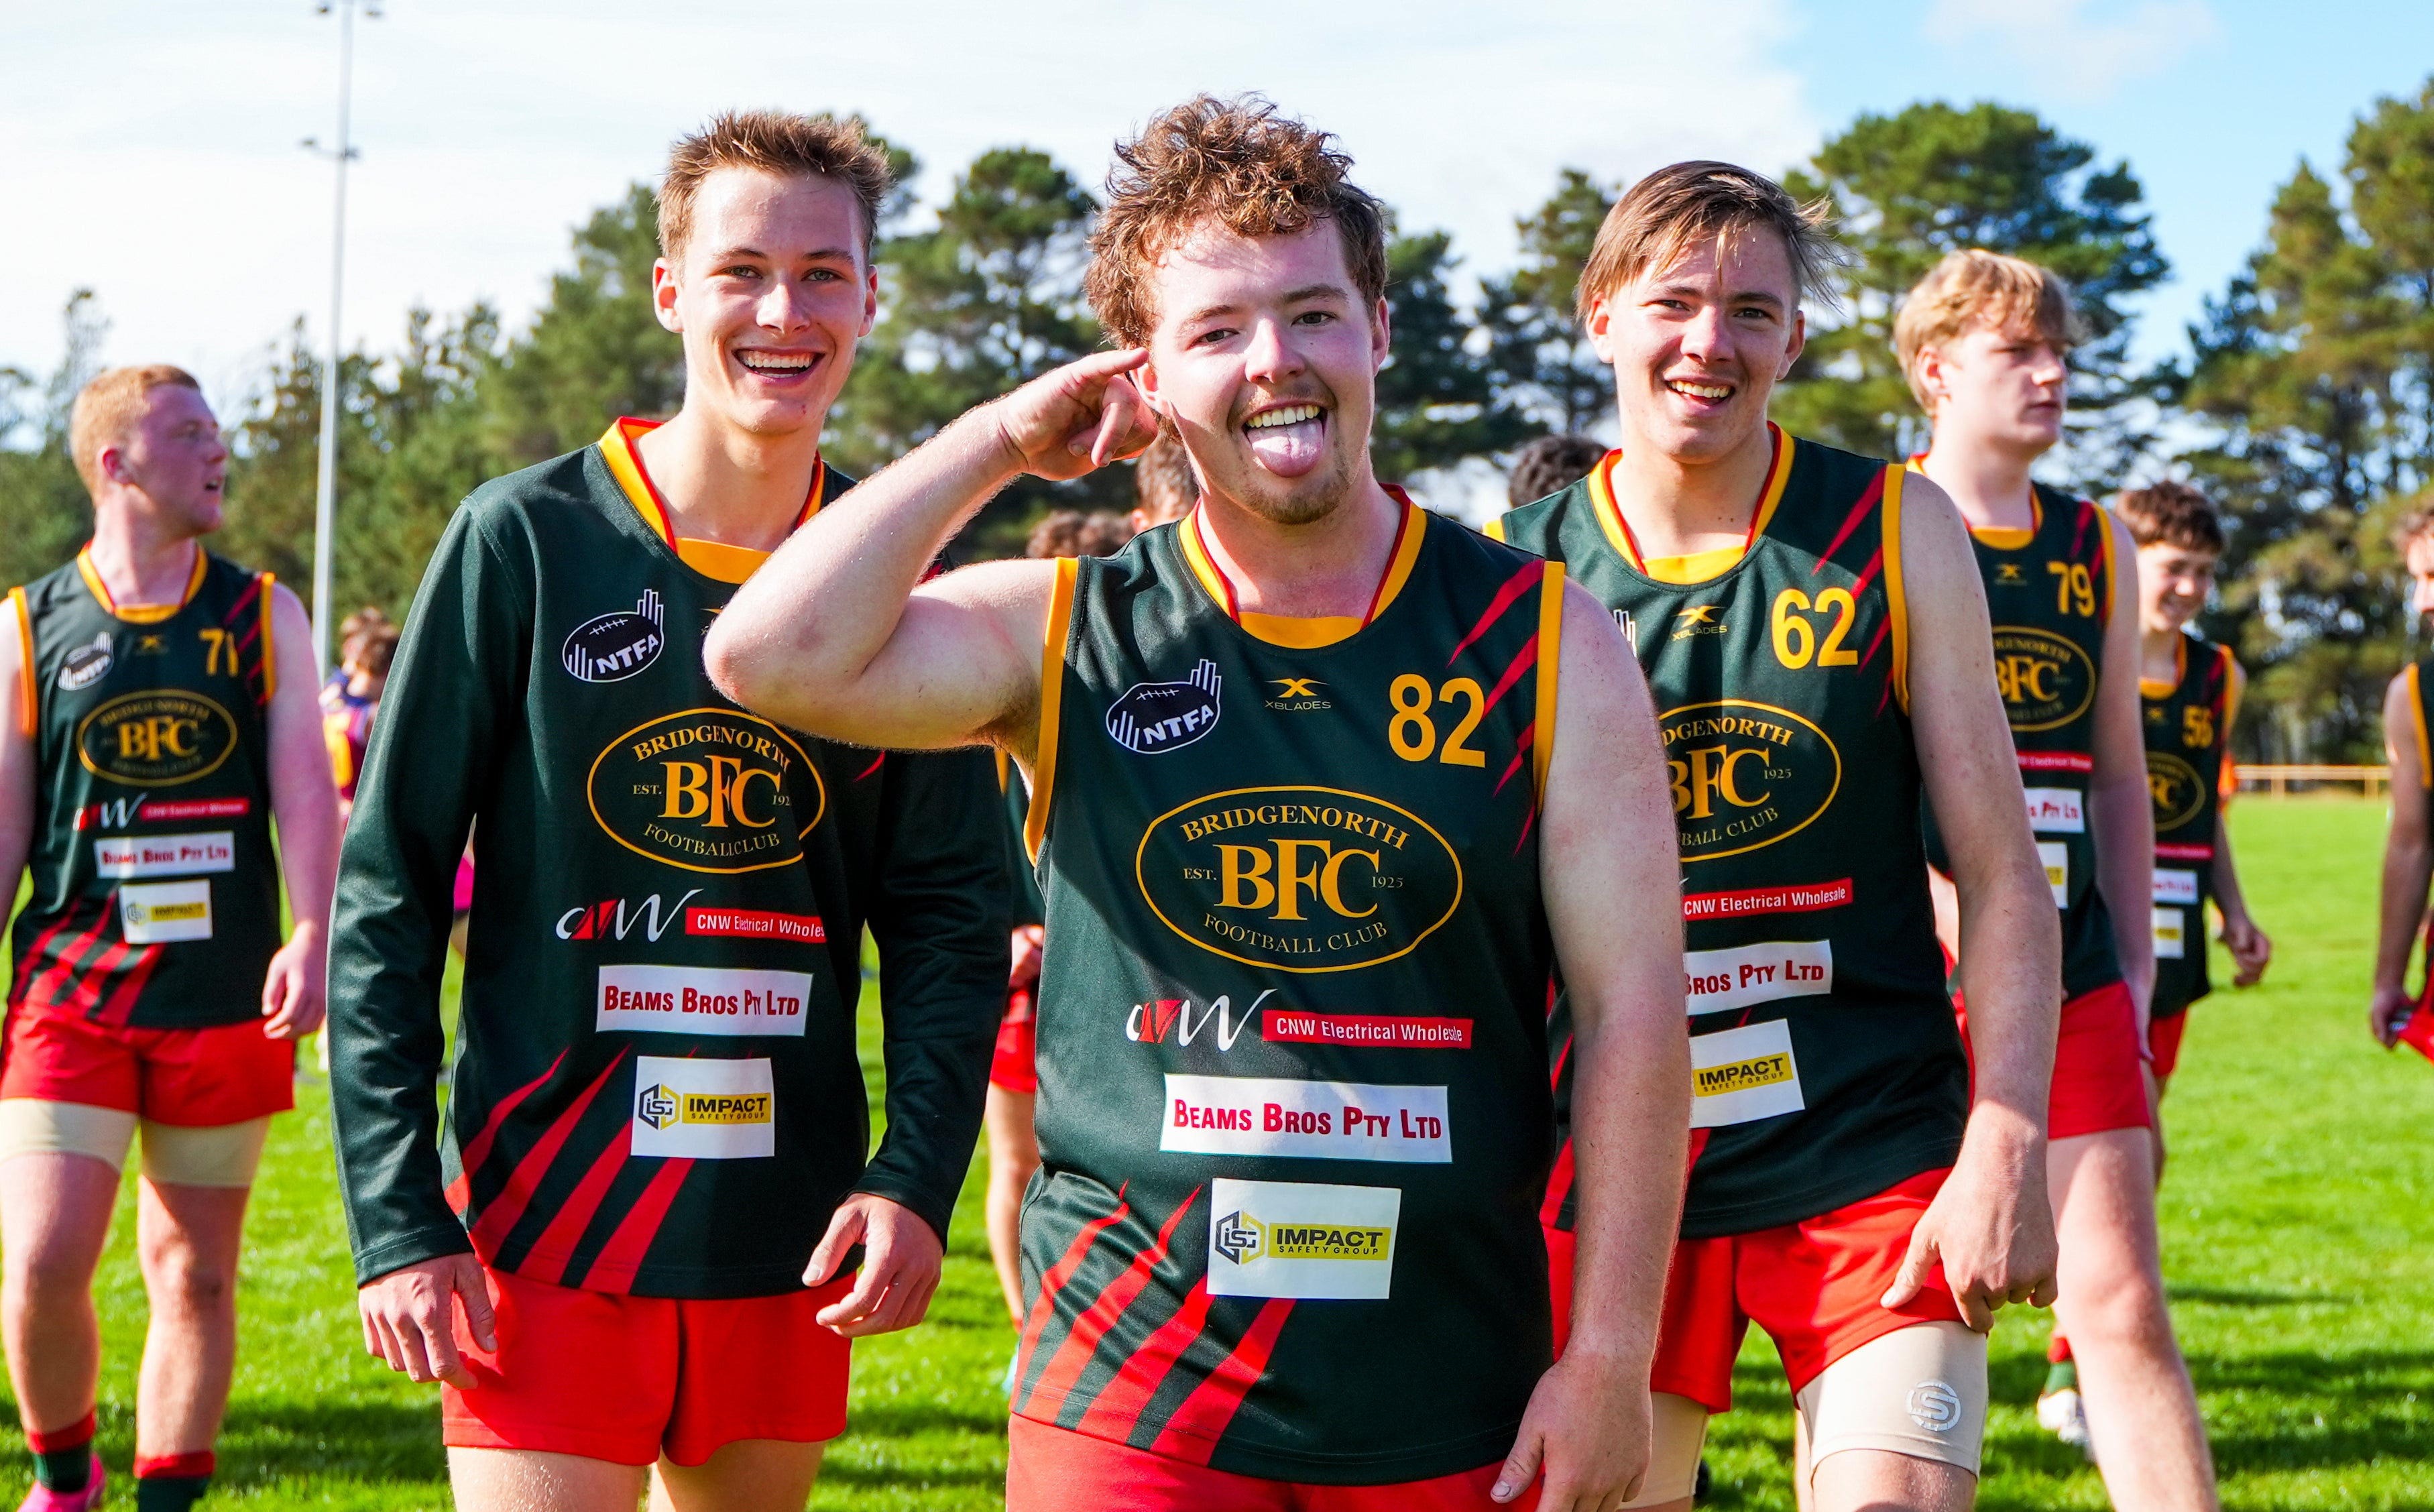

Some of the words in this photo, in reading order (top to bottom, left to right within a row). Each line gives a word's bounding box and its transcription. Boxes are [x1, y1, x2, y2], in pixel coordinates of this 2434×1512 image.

[2047, 561, 2095, 617] 79
[1672, 625, 1727, 641] XBLADES
[1772, 587, 1858, 670] 62
[199, 628, 238, 676] 71
[595, 634, 659, 675] NTFA
[1265, 699, 1331, 711] XBLADES
[1143, 704, 1214, 744] NTFA
[1389, 673, 1485, 768] 82
[119, 715, 199, 760] BFC
[632, 725, 791, 775] BRIDGENORTH
[1763, 768, 1792, 780] 1925
[632, 784, 662, 795] EST.
[657, 755, 782, 828] BFC
[1179, 805, 1411, 851] BRIDGENORTH
[1727, 807, 1778, 837] CLUB
[1183, 868, 1217, 881] EST.
[1213, 838, 1380, 921] BFC
[1371, 876, 1403, 888] 1925
[1684, 898, 1717, 917] CNW
[1721, 893, 1787, 913] Electrical
[1791, 886, 1846, 907] Wholesale
[697, 915, 731, 931] CNW
[1204, 913, 1321, 953] FOOTBALL
[1328, 921, 1388, 951] CLUB
[1739, 964, 1776, 988] PTY
[1785, 960, 1824, 981] LTD
[604, 985, 674, 1012] BEAMS
[682, 987, 738, 1015] BROS
[766, 990, 800, 1016] LTD
[1276, 1017, 1316, 1036] CNW
[1321, 1020, 1396, 1041] Electrical
[1401, 1023, 1463, 1043] Wholesale
[1698, 1057, 1784, 1087] IMPACT
[1703, 1078, 1745, 1093] SAFETY
[1747, 1071, 1785, 1085] GROUP
[689, 1096, 768, 1114] IMPACT
[691, 1112, 734, 1121] SAFETY
[736, 1111, 765, 1120] GROUP
[1173, 1098, 1253, 1132] BEAMS
[1263, 1102, 1332, 1135] BROS
[1343, 1106, 1391, 1138] PTY
[1400, 1109, 1442, 1139] LTD
[1276, 1228, 1383, 1248] IMPACT
[1278, 1245, 1329, 1254] SAFETY
[1333, 1246, 1379, 1255] GROUP
